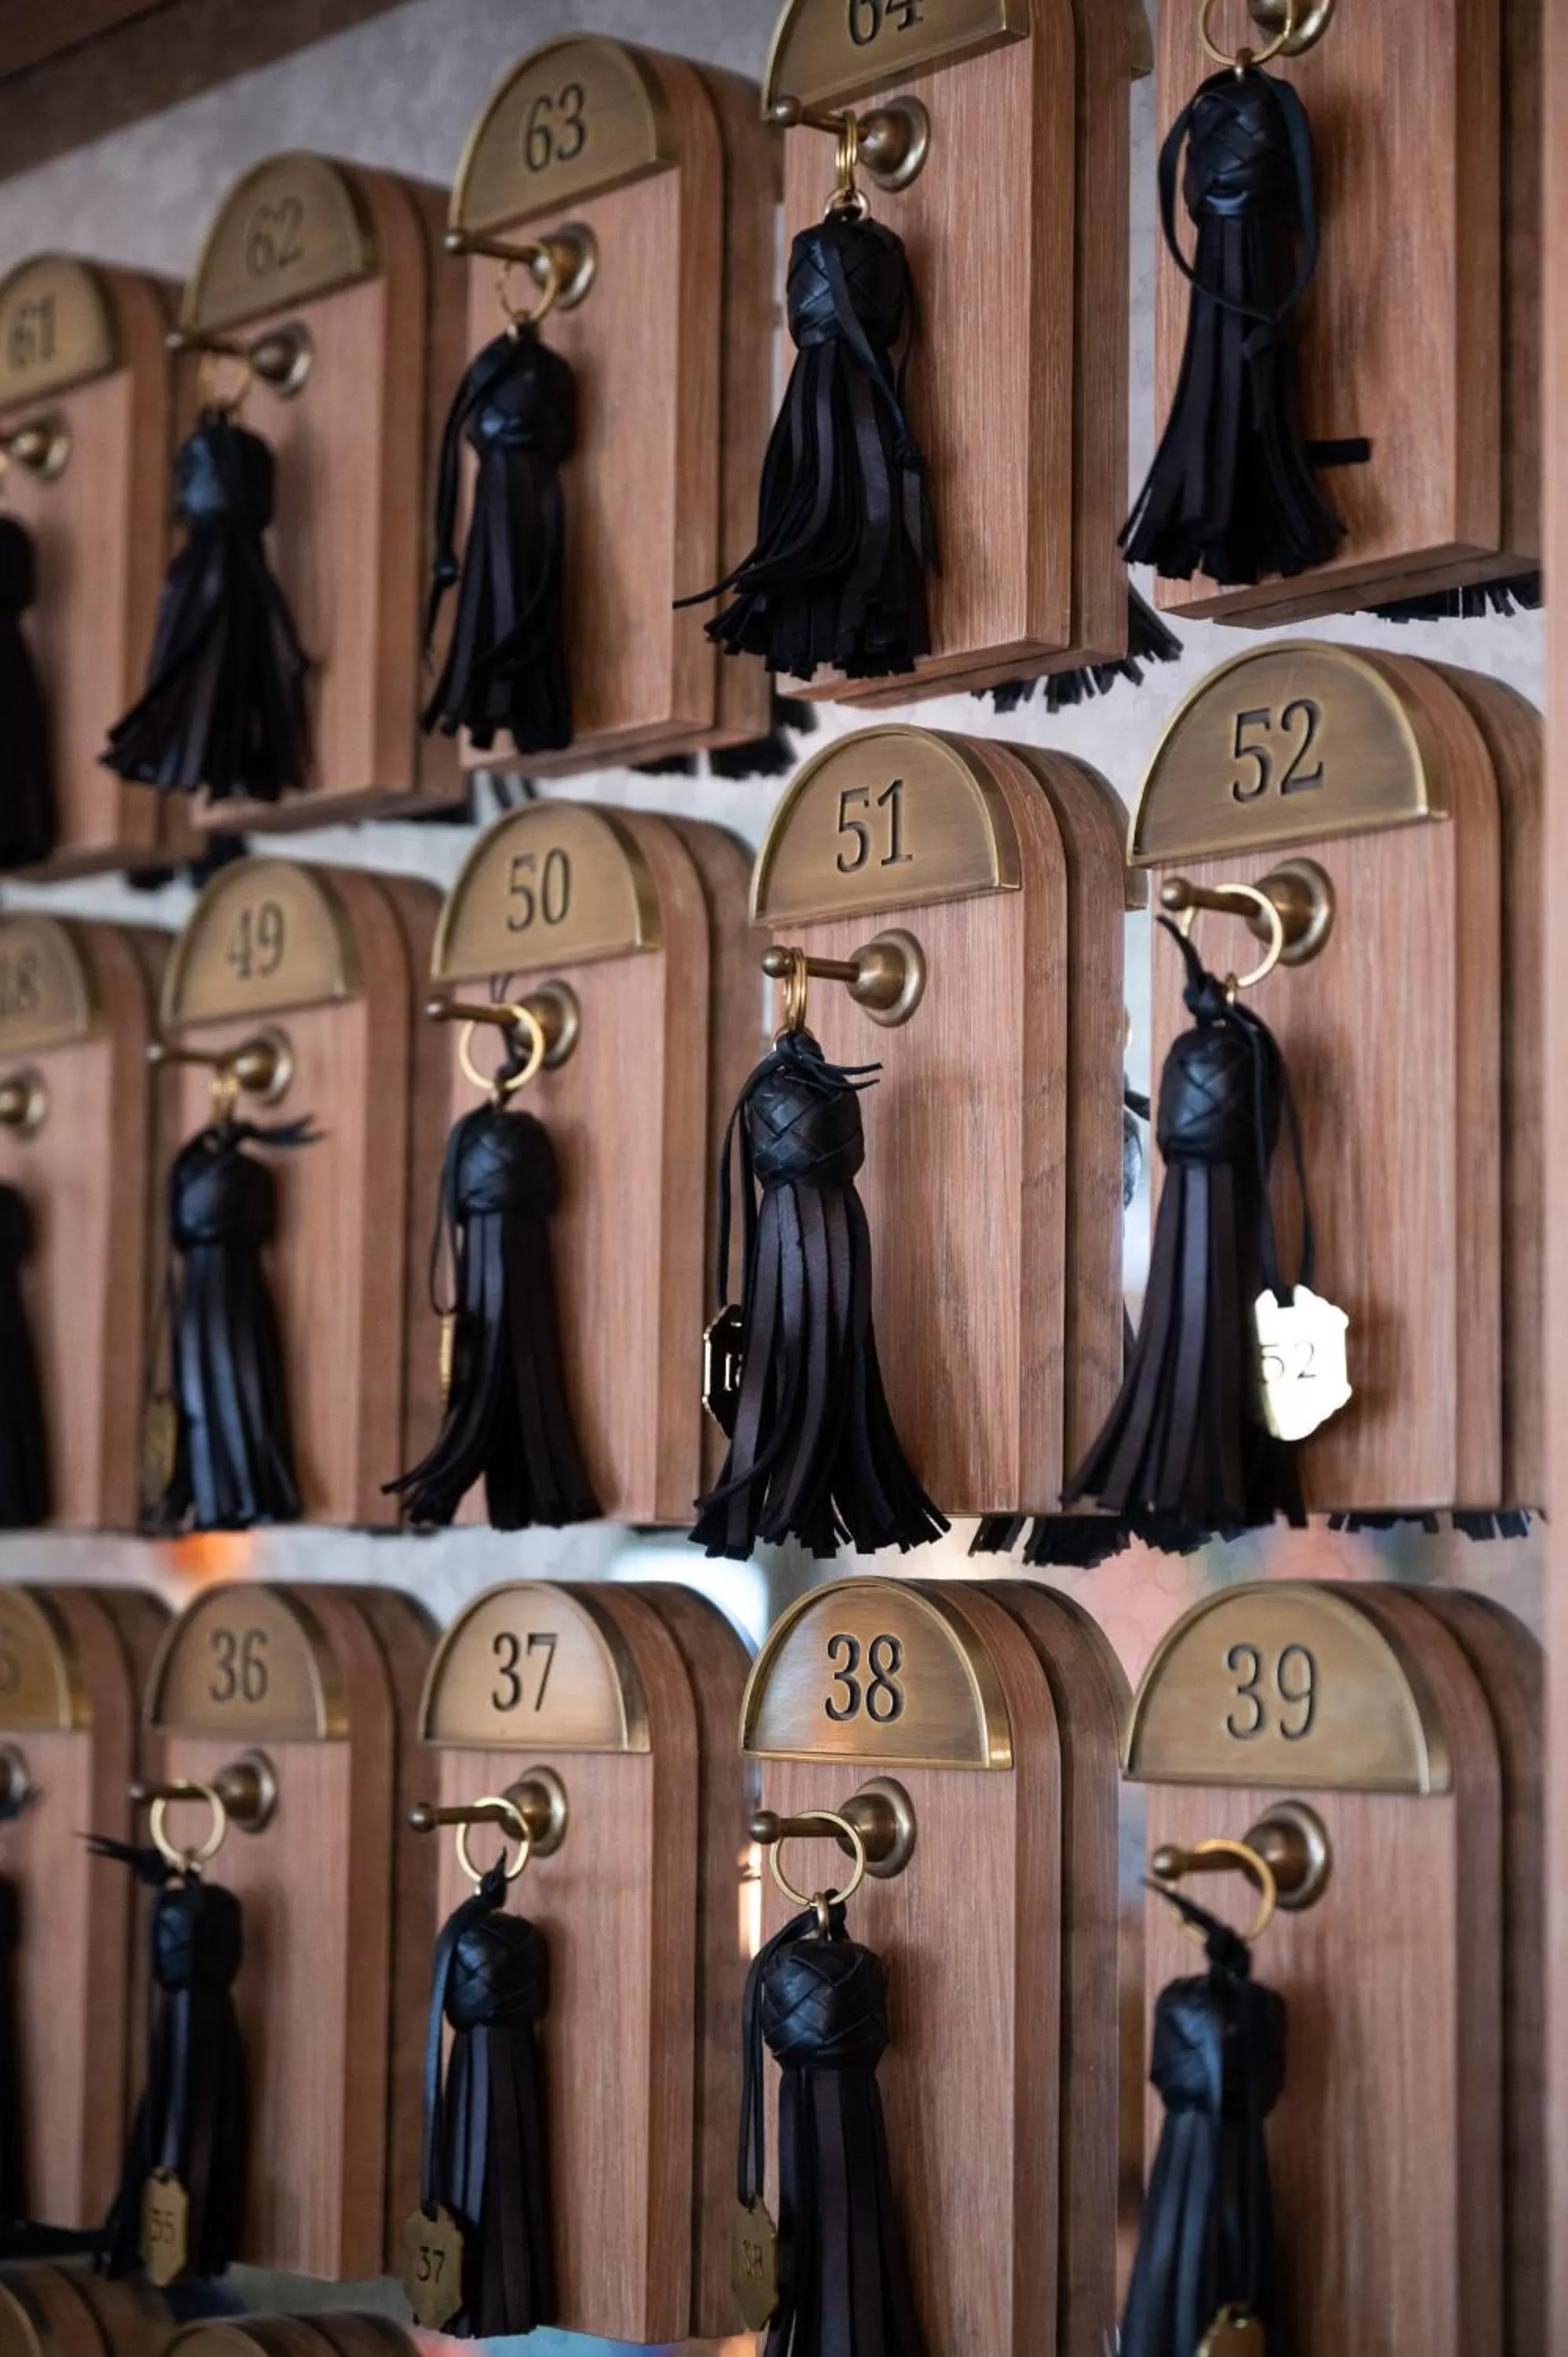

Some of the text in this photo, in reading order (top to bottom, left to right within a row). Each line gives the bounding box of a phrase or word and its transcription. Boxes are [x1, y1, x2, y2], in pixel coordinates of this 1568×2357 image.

[526, 82, 586, 173] 63
[246, 196, 304, 280] 62
[1233, 698, 1323, 802] 52
[837, 779, 913, 873] 51
[507, 848, 570, 932] 50
[225, 901, 285, 980] 49
[209, 1626, 268, 1703] 36
[492, 1632, 558, 1712] 37
[825, 1634, 903, 1722] 38
[1227, 1643, 1318, 1741] 39
[416, 2246, 445, 2285] 37
